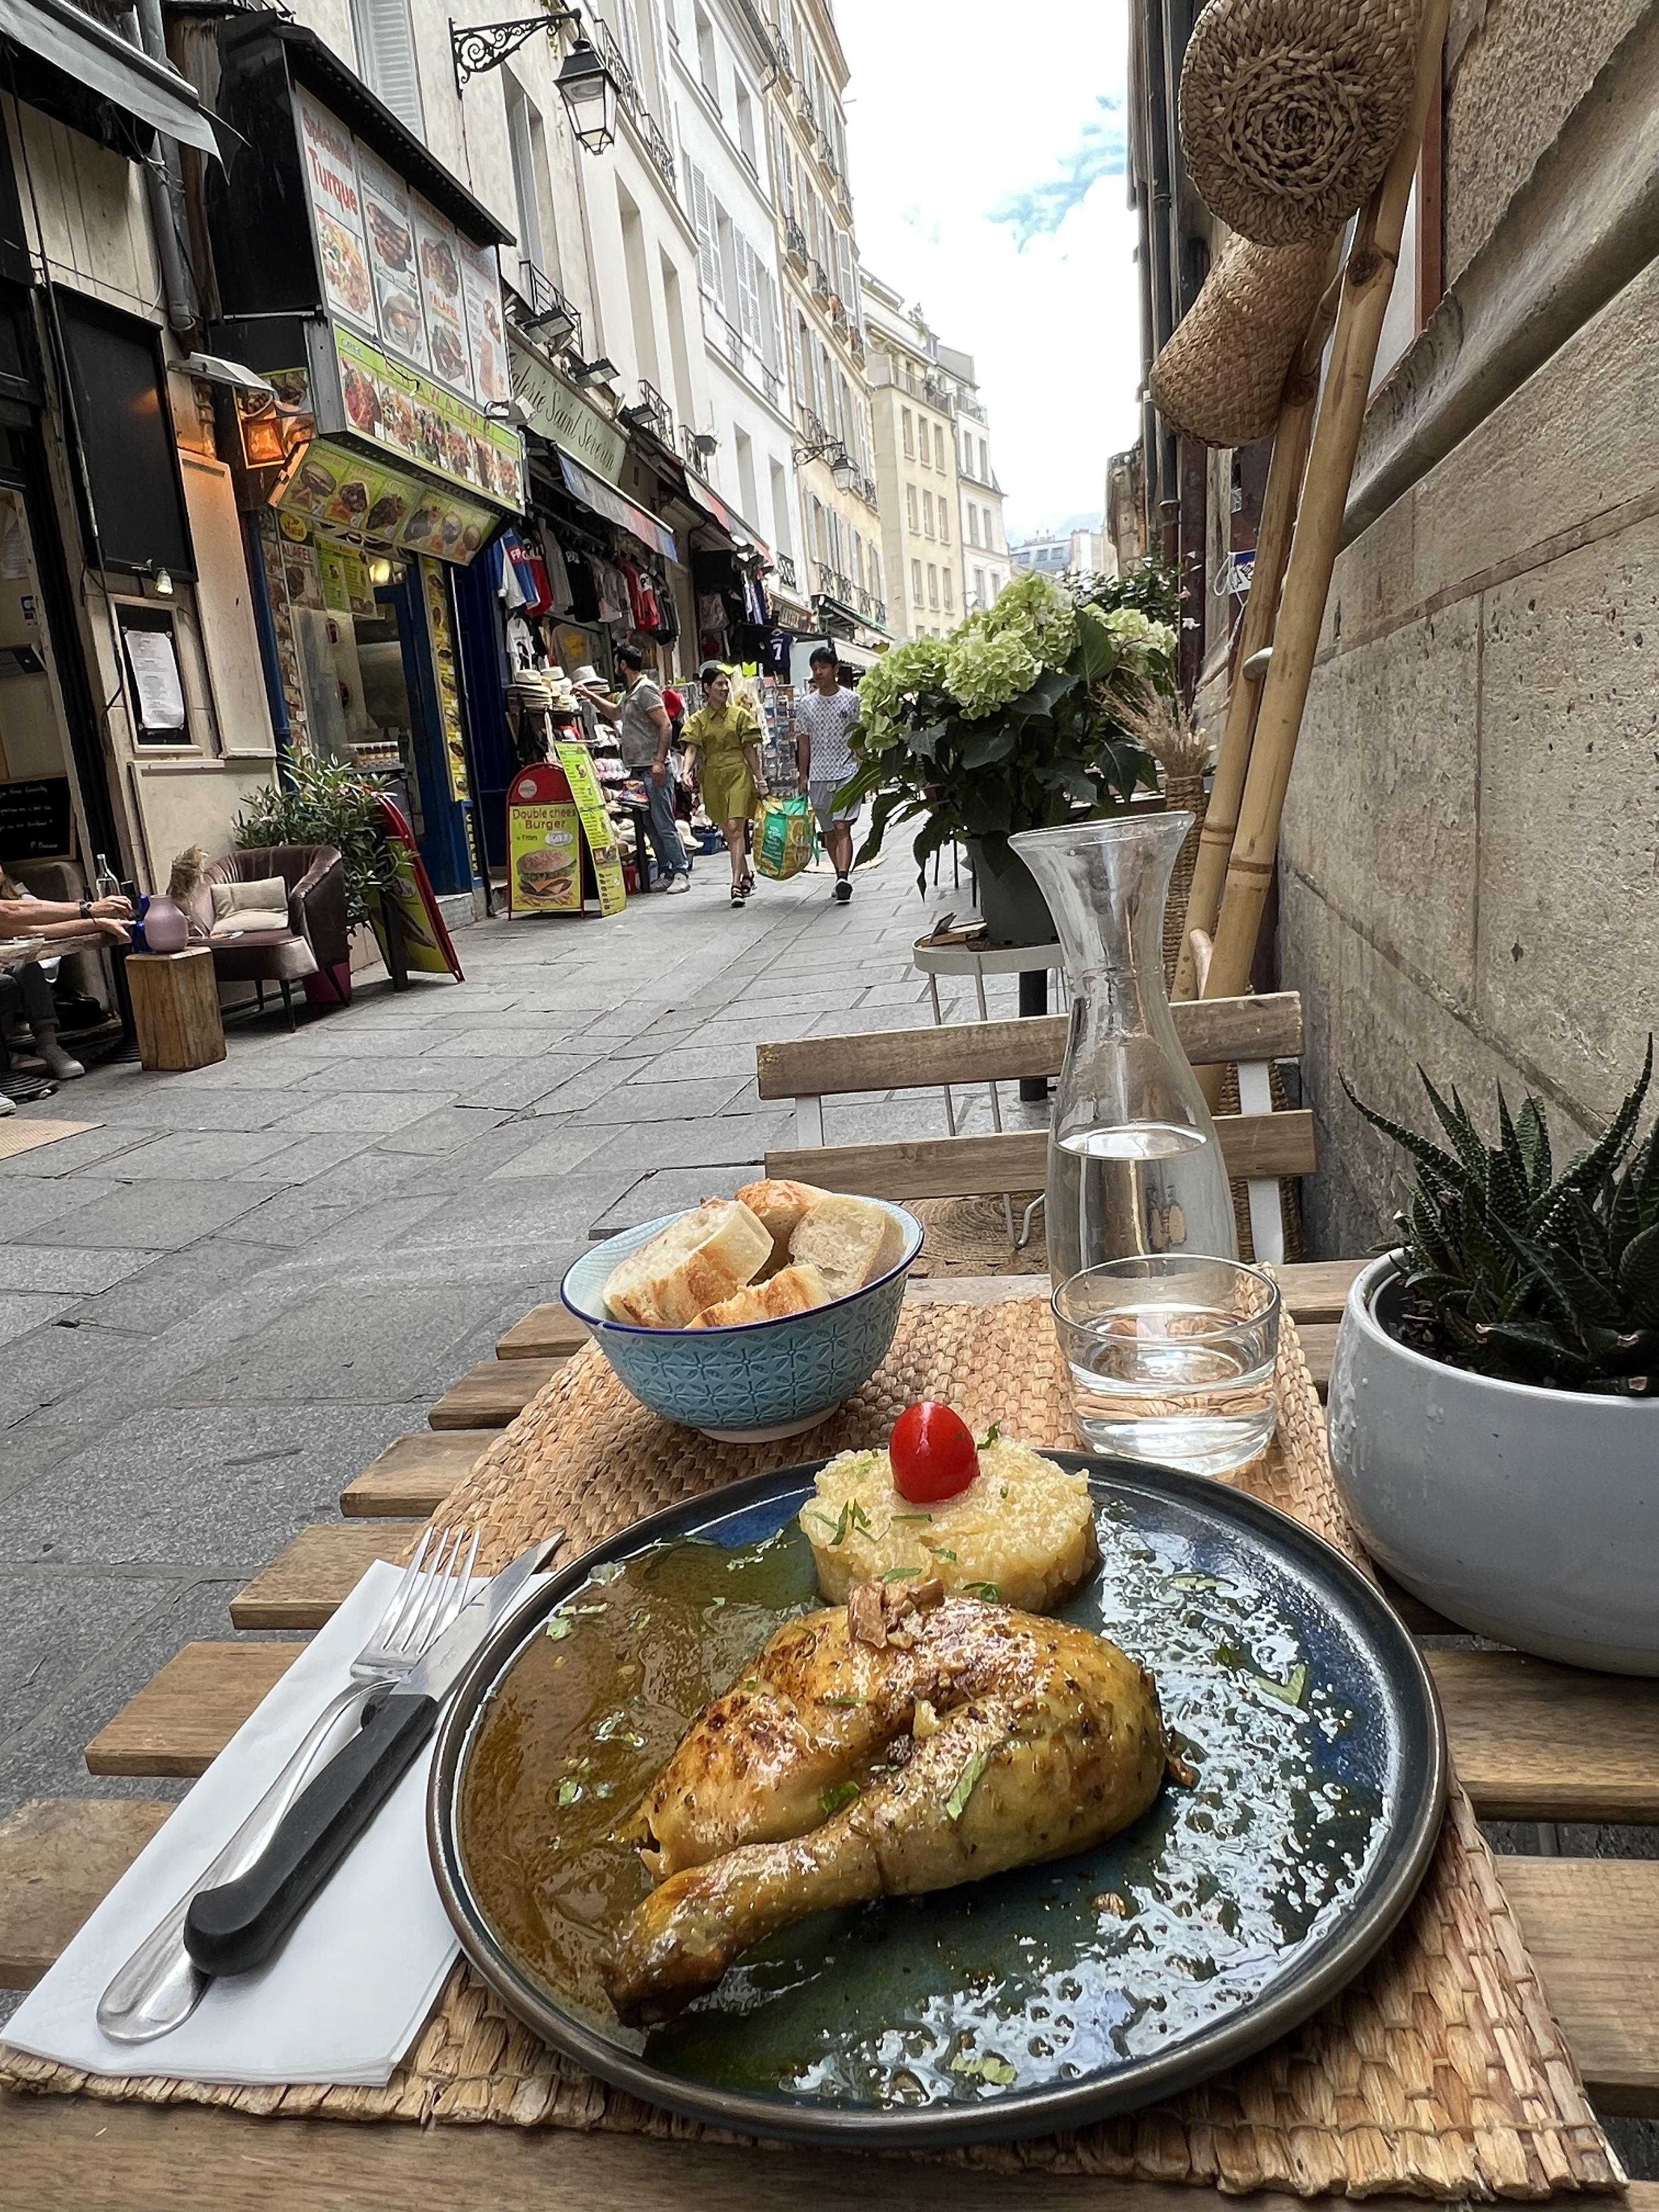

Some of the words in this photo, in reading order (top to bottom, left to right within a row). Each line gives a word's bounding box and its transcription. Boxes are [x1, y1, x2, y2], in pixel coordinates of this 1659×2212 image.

[308, 145, 358, 213] Turque
[546, 390, 584, 439] Saint
[772, 643, 782, 661] 7
[513, 808, 547, 820] Double
[526, 820, 566, 831] Burger
